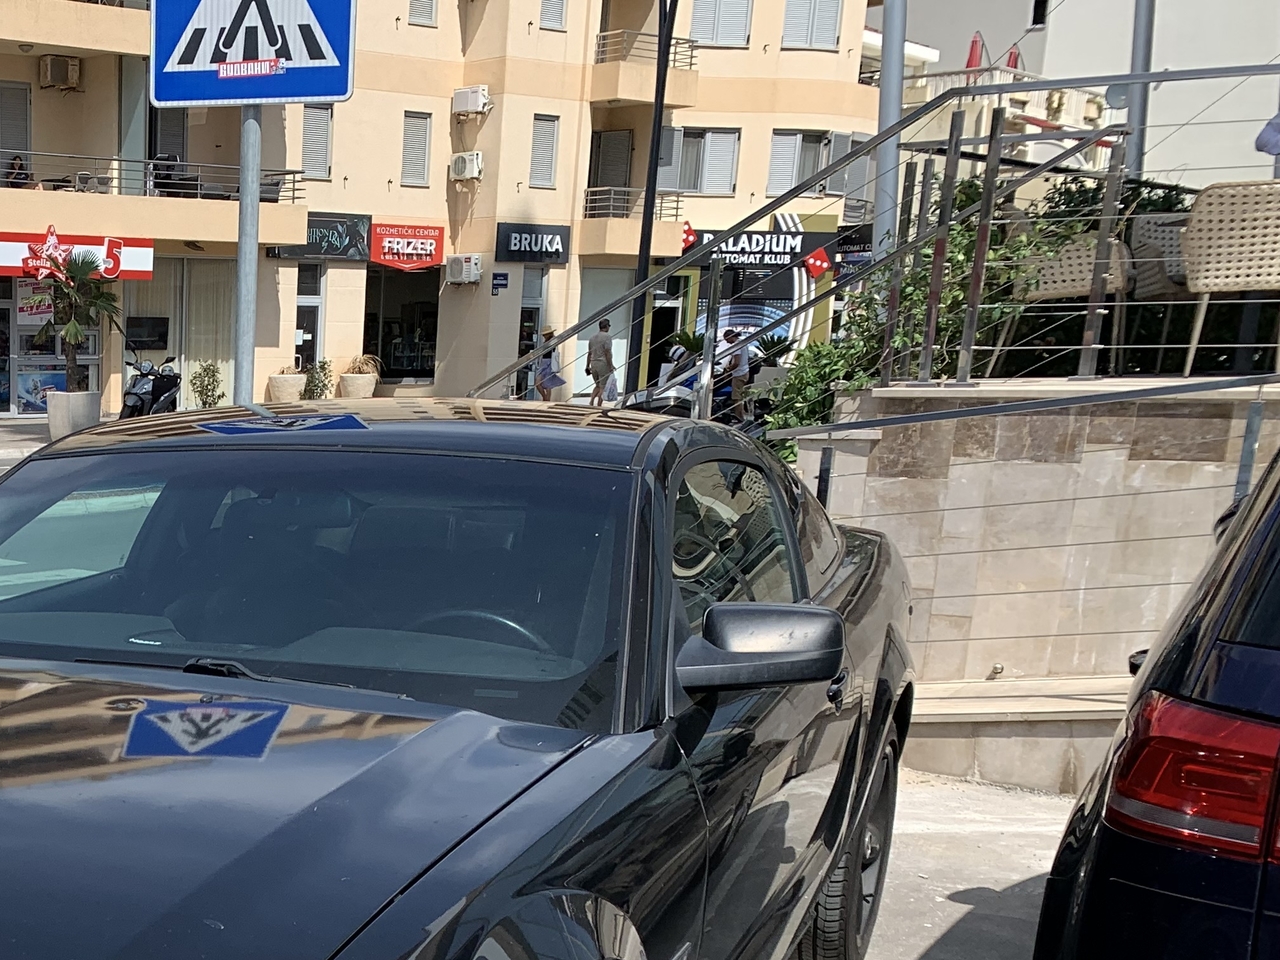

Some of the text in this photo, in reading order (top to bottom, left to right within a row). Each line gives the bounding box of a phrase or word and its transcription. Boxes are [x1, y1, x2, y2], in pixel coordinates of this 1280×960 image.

[376, 226, 439, 237] KOZMETIČKI CENTAR
[382, 237, 437, 255] FRIZER
[510, 232, 564, 253] BRUKA
[27, 258, 51, 268] Stella
[102, 236, 124, 279] 5
[763, 254, 792, 265] KLUB
